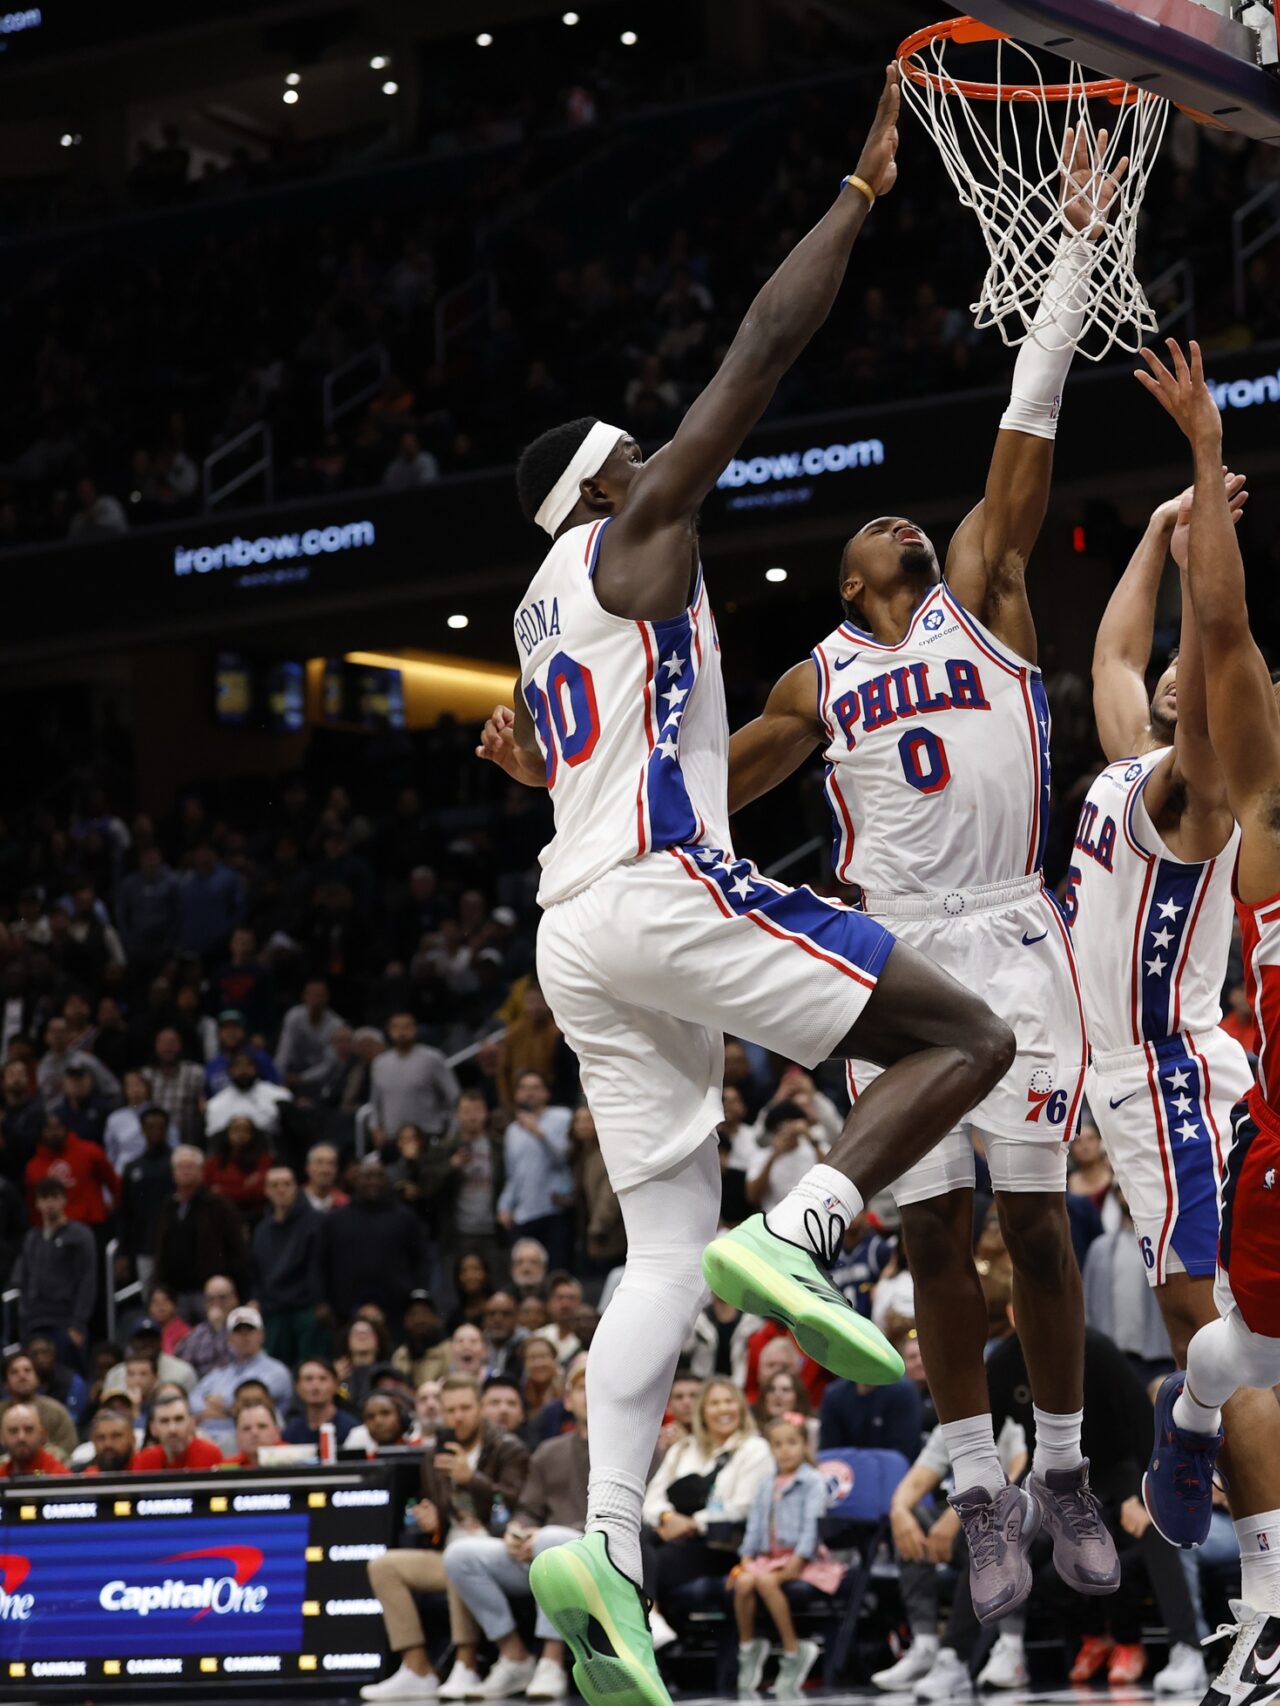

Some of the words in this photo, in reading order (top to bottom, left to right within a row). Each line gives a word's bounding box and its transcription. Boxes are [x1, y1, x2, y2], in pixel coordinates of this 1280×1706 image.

[717, 438, 885, 489] bow.com
[174, 520, 375, 576] ironbow.com
[515, 597, 561, 656] BONA
[918, 624, 960, 647] crypto.com
[832, 659, 992, 752] PHILA
[898, 727, 952, 794] 0
[1025, 1088, 1068, 1124] 76
[1138, 1235, 1155, 1269] 6
